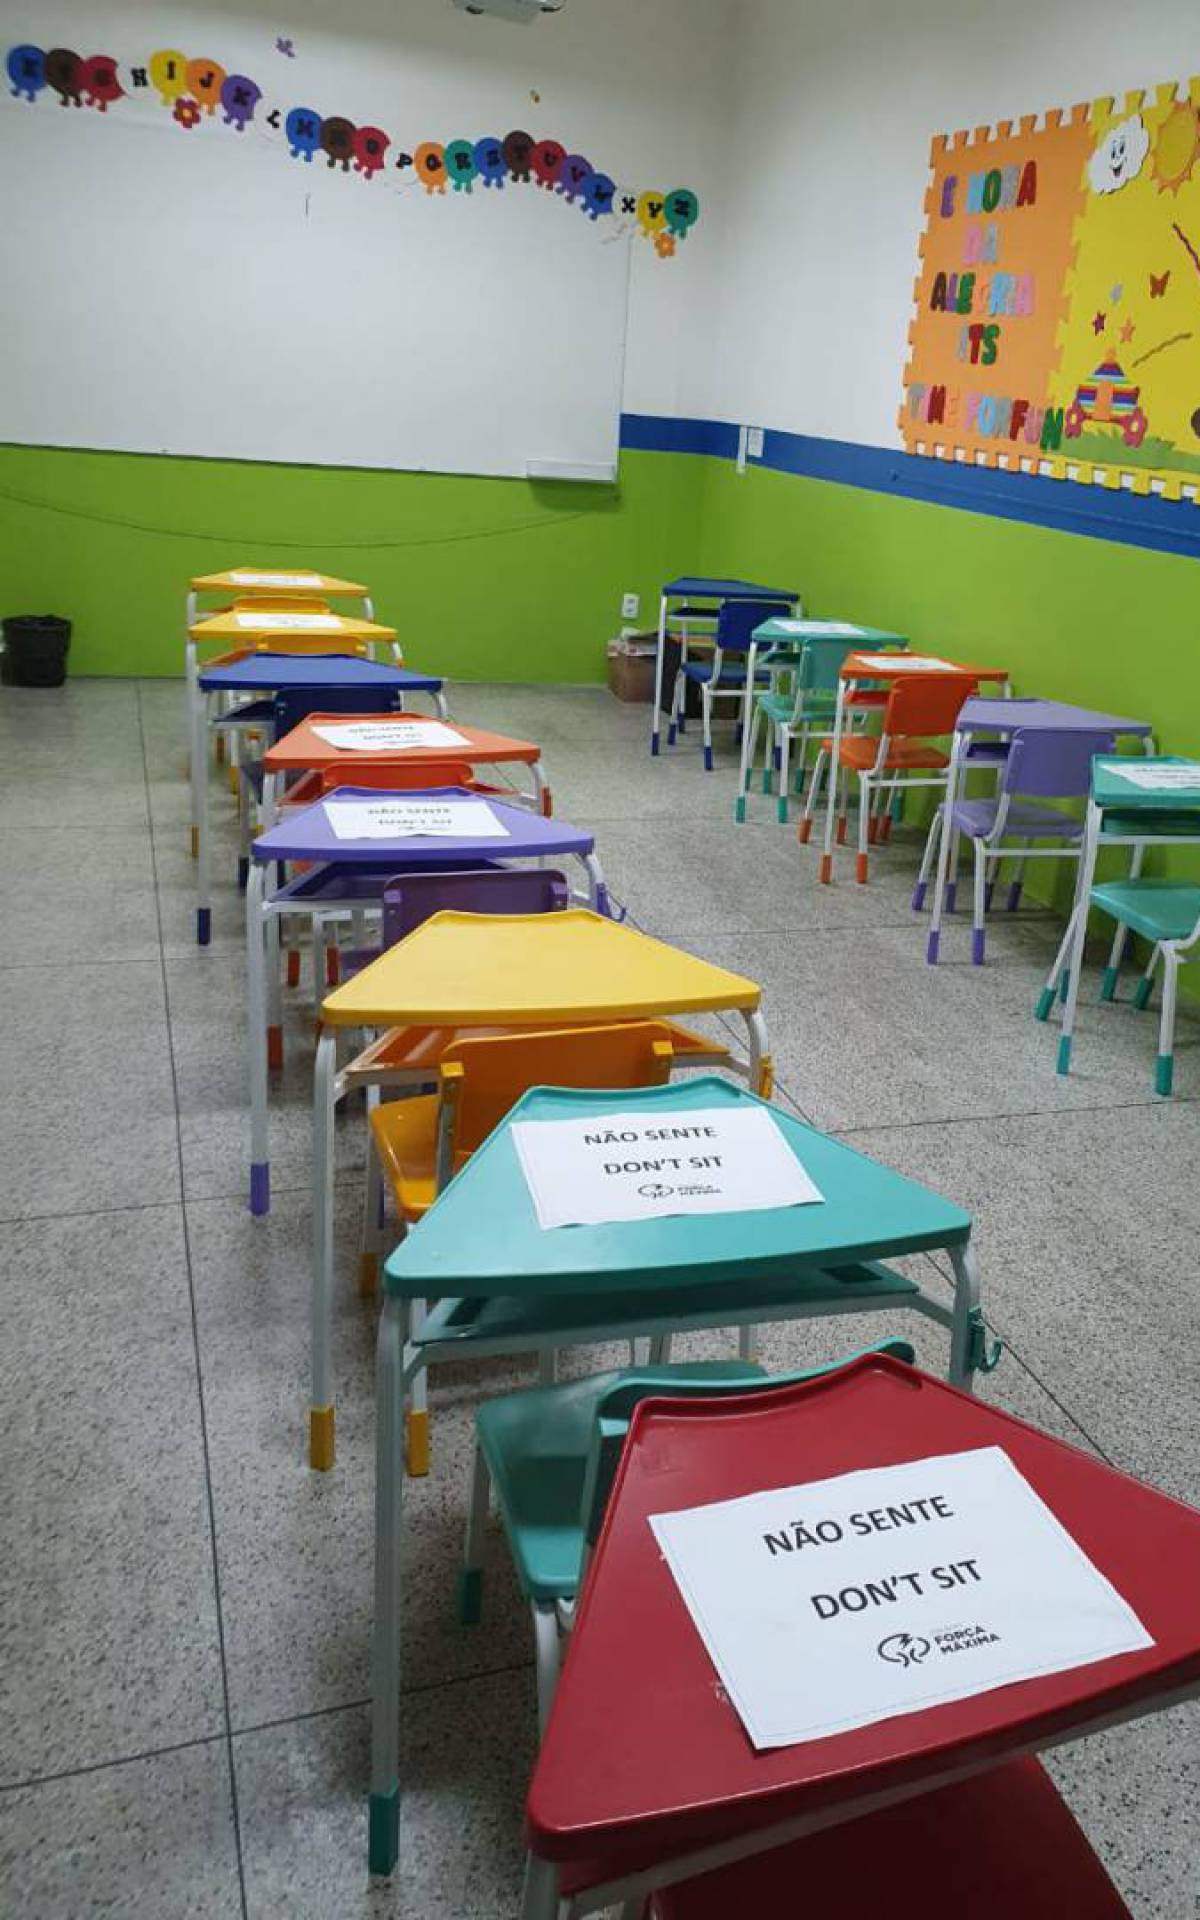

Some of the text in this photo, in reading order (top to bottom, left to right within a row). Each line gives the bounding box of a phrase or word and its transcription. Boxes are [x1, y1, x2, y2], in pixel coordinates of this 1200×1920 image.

[622, 197, 636, 213] X
[648, 201, 663, 218] Y
[584, 1126, 717, 1145] NÃO SENTE
[689, 1155, 722, 1168] SIT
[763, 1495, 954, 1555] NÃO SENTE
[811, 1559, 982, 1620] DON'T SIT
